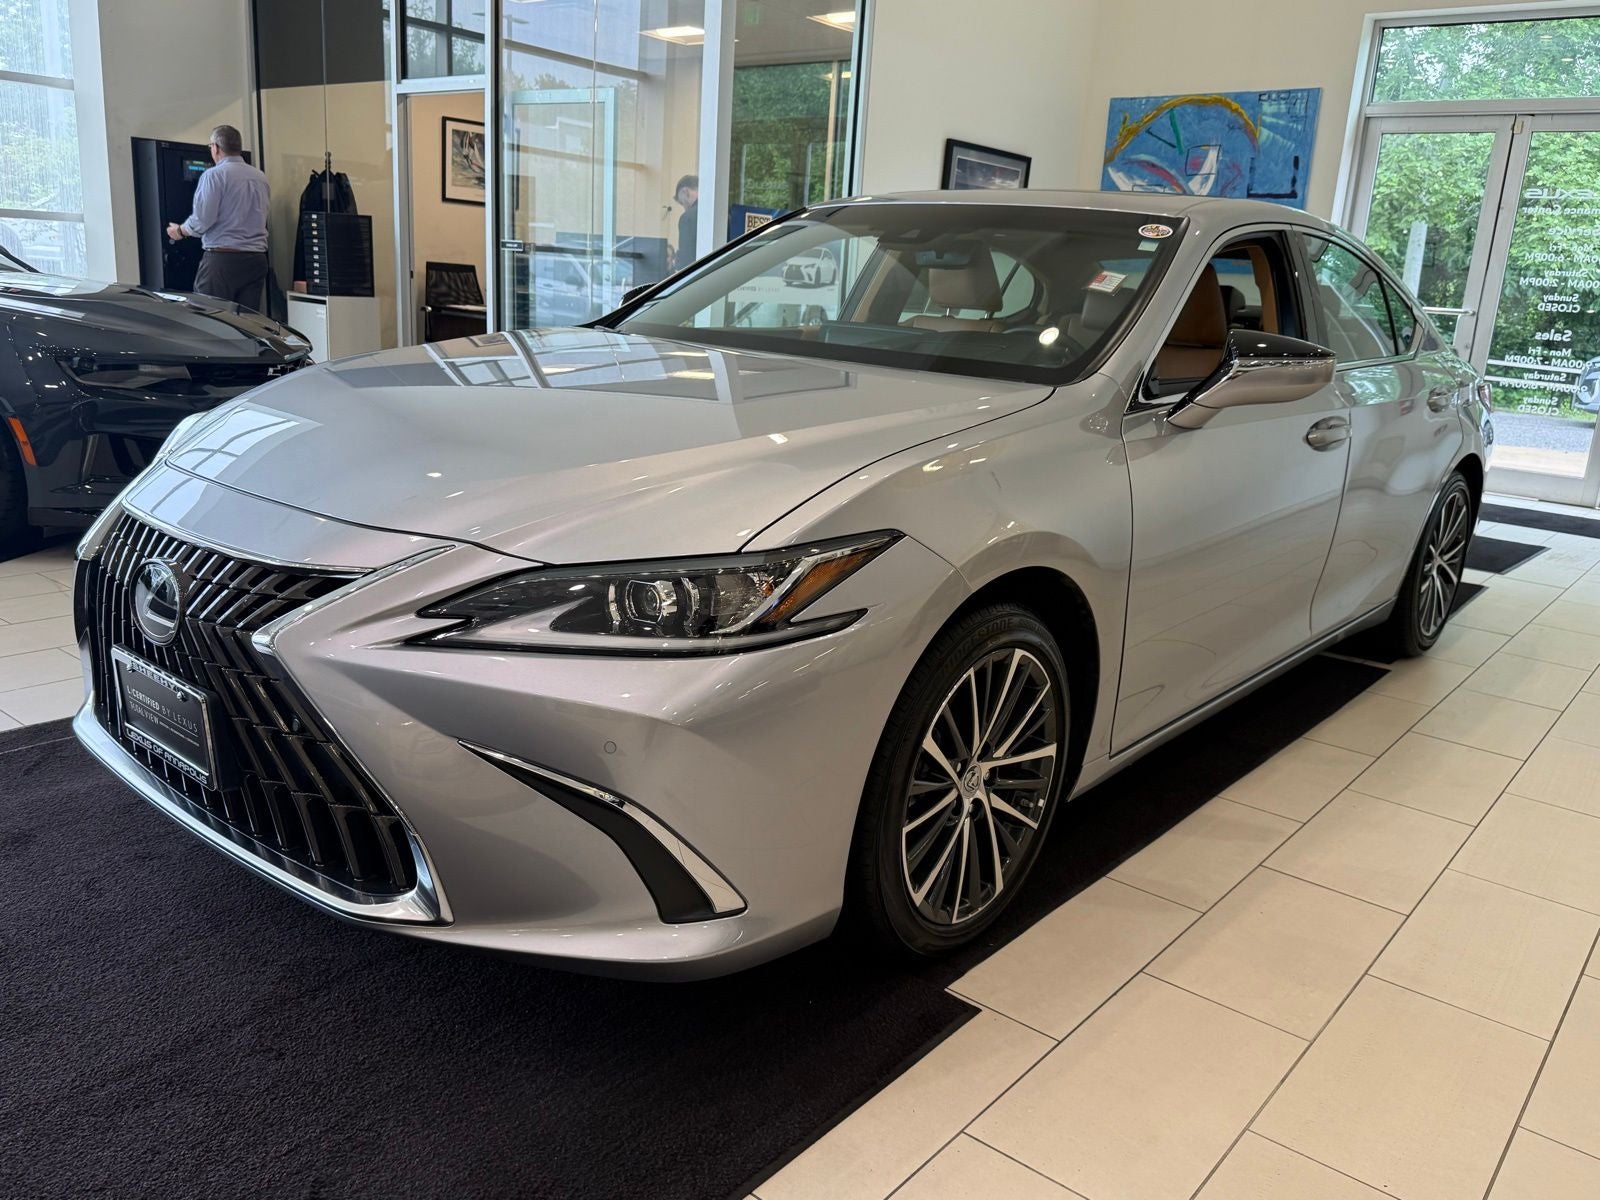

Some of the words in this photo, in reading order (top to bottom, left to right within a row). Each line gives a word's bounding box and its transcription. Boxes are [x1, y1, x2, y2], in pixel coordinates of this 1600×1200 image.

[162, 705, 170, 716] BY
[172, 712, 198, 732] LEXUS
[126, 728, 152, 749] LEXUS
[153, 744, 164, 755] OF
[164, 752, 208, 784] ANNAPOLIS
